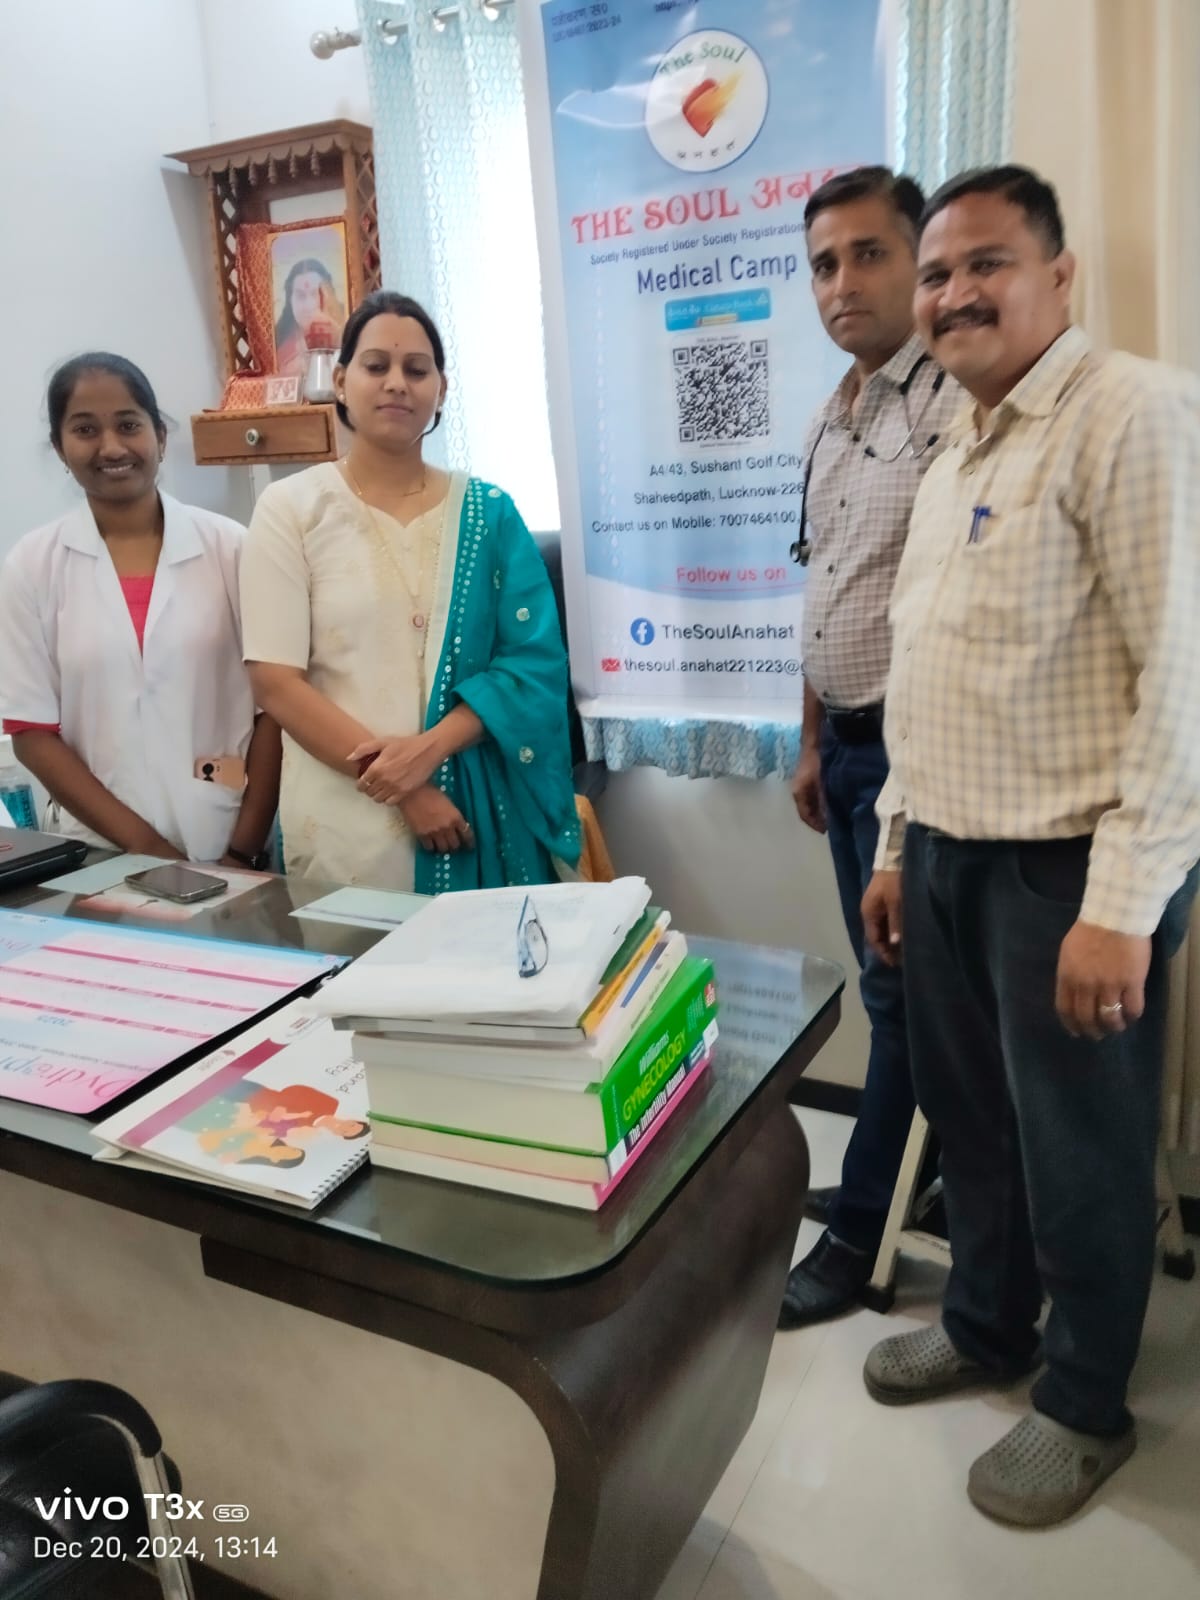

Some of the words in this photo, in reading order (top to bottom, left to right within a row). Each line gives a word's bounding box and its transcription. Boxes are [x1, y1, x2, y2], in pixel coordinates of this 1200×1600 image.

[700, 41, 749, 63] Soul
[571, 206, 634, 244] THE
[643, 187, 740, 231] SOUL
[590, 251, 620, 266] Society
[622, 242, 669, 260] Registered
[672, 238, 699, 252] Under
[702, 231, 738, 247] Society
[637, 257, 723, 294] Medical
[730, 253, 798, 281] Camp
[691, 458, 742, 474] Sushant
[746, 454, 773, 470] Golf
[634, 488, 715, 505] Shaheedpath,
[592, 519, 634, 533] Contact
[638, 520, 650, 531] us
[654, 519, 669, 531] on
[672, 515, 716, 530] Mobile:
[676, 567, 731, 583] Follow
[737, 568, 757, 581] us
[764, 566, 787, 581] on
[662, 624, 795, 640] TheSoulAnahat
[623, 1027, 686, 1121] GYNECOLOGY
